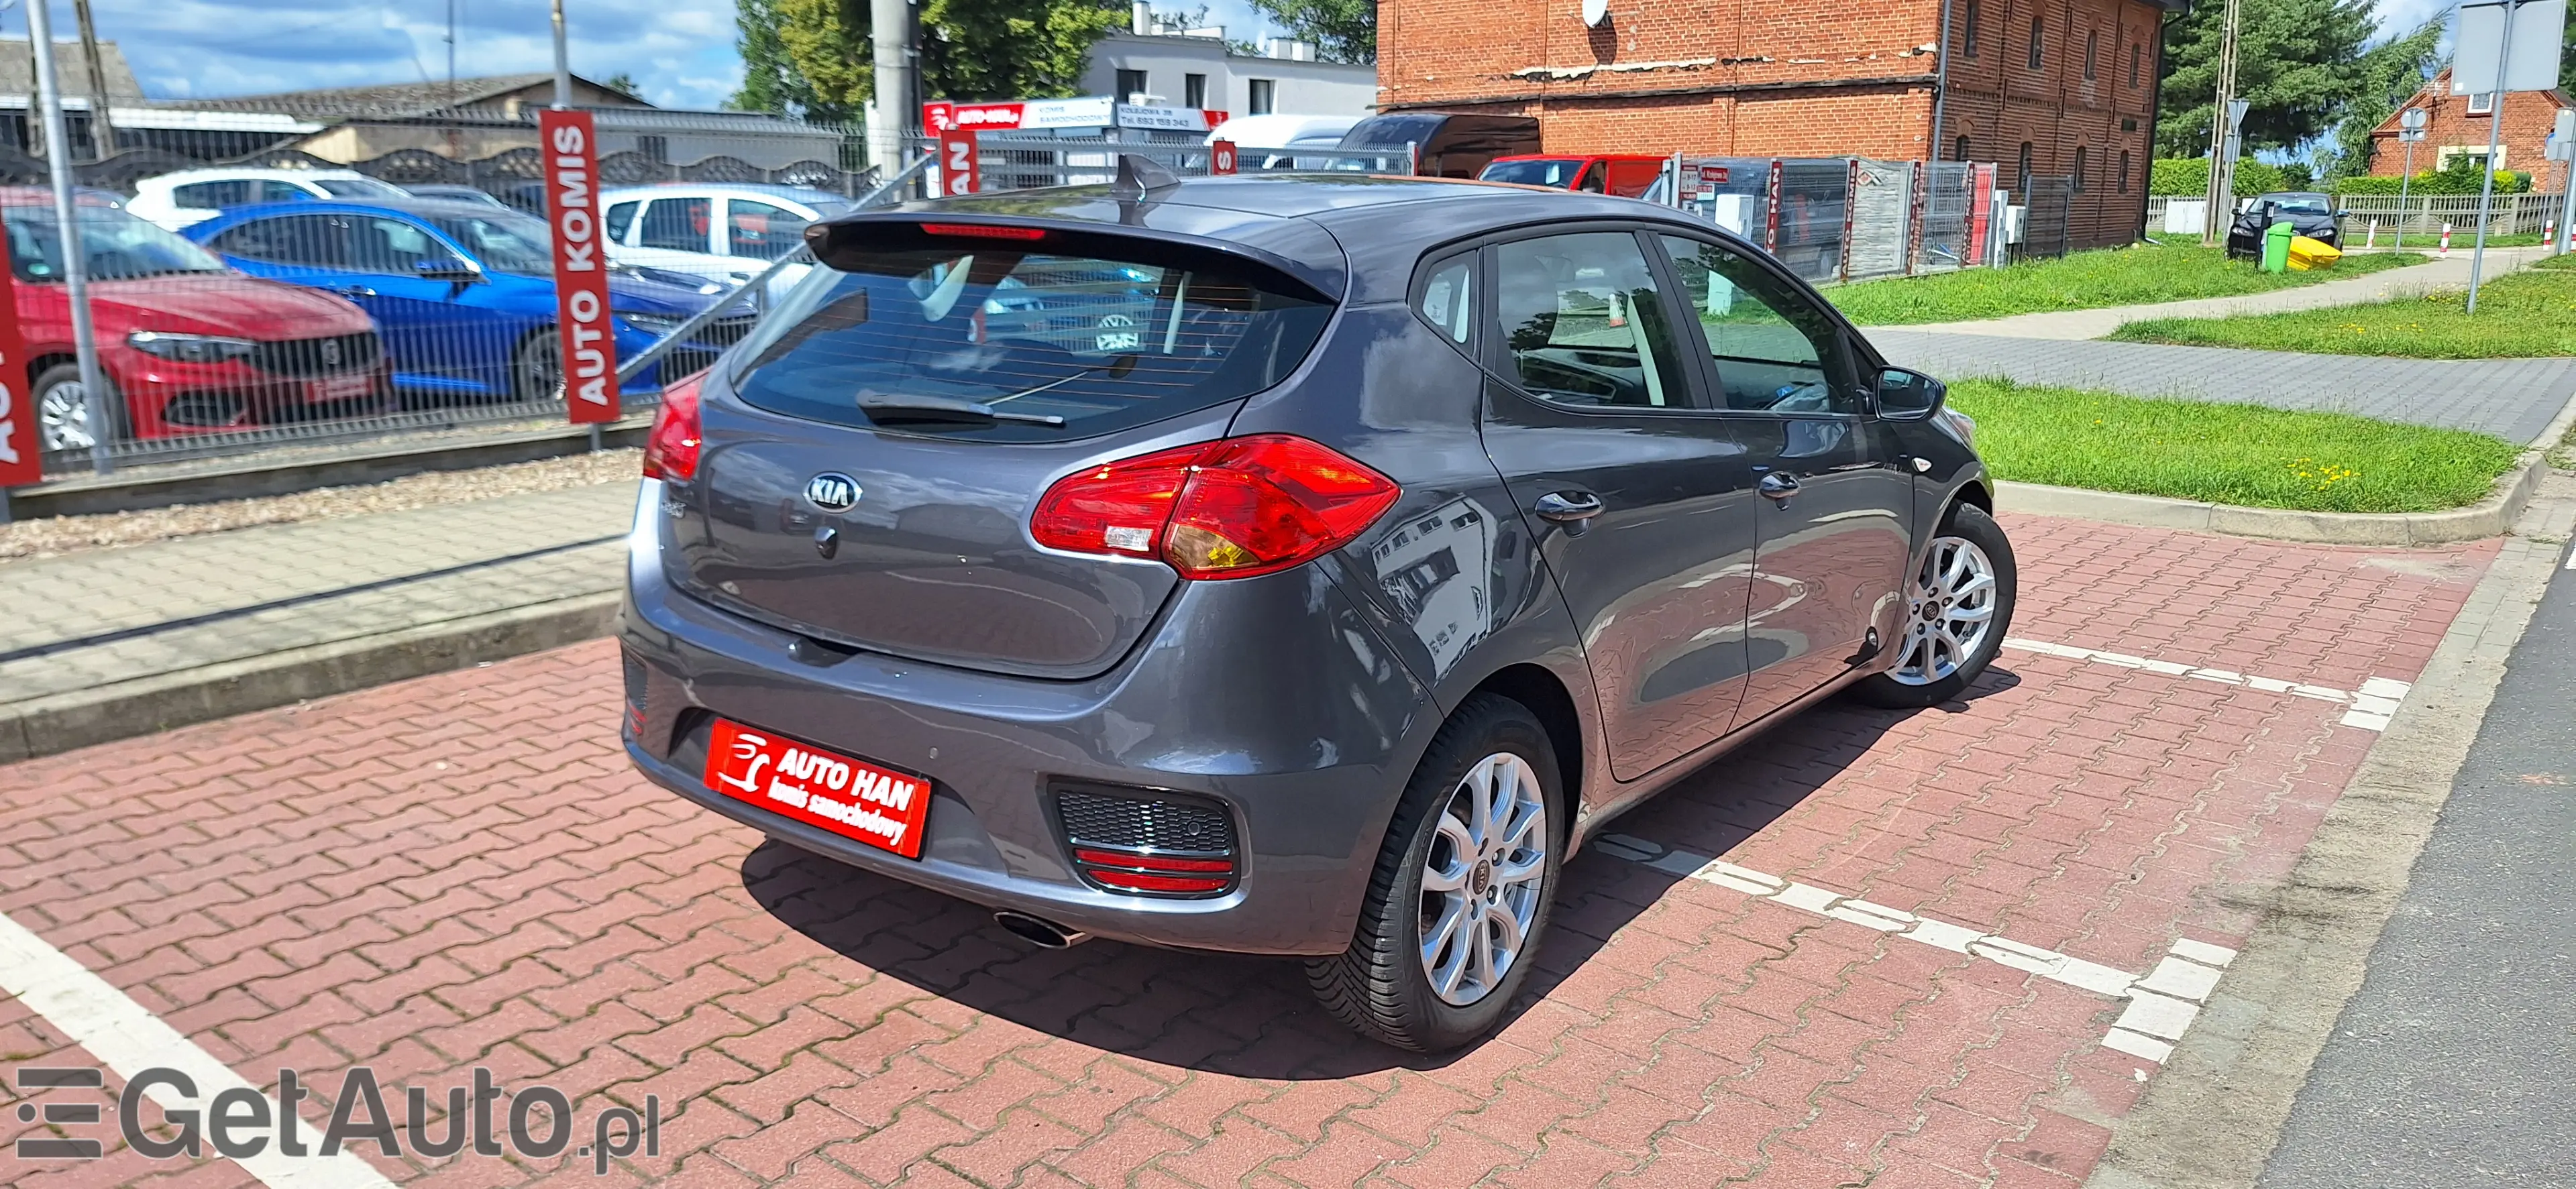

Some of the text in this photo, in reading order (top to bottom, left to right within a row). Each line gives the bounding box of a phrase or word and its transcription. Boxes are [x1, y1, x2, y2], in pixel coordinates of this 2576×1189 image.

[1841, 166, 1856, 276] AUTO KOMIS
[553, 125, 608, 406] AUTO KOMIS
[812, 478, 849, 507] KIA
[767, 775, 908, 846] komis samochodowy
[777, 748, 914, 812] AUTO HAN
